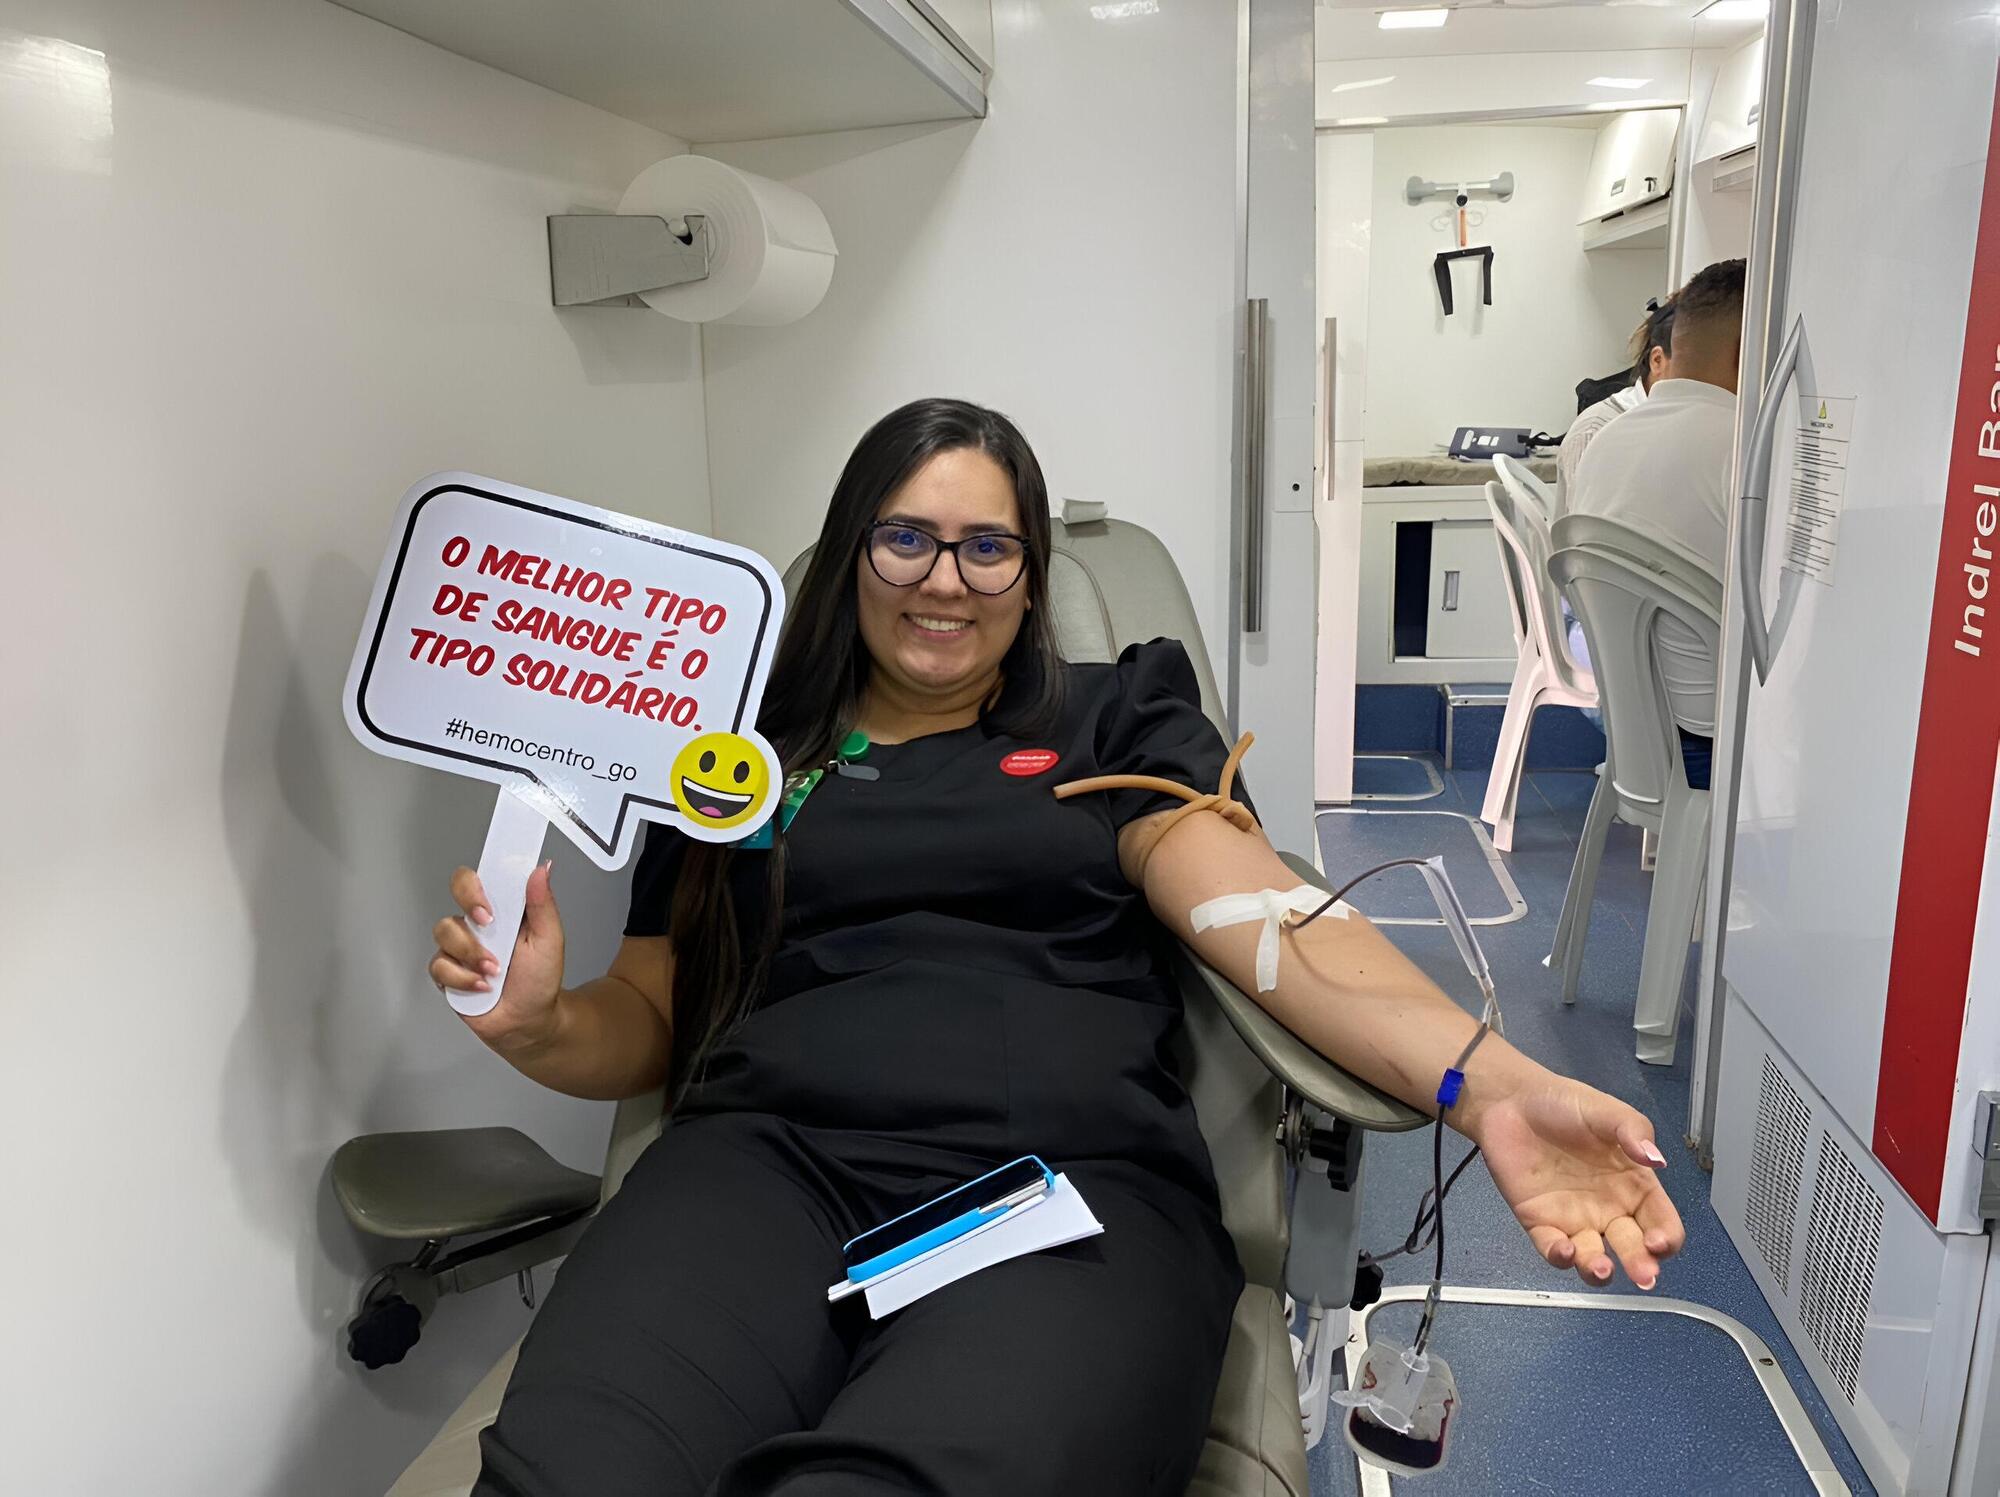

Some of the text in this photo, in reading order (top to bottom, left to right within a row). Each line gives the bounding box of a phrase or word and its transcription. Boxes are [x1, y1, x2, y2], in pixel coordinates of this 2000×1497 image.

[1955, 343, 2000, 656] Indrel Ba
[432, 584, 710, 681] DE SANGUE É O
[442, 536, 728, 636] O MELHOR TIPO
[409, 627, 702, 732] TIPO SOLIDÁRIO.
[445, 717, 638, 783] #hemocentro_go
